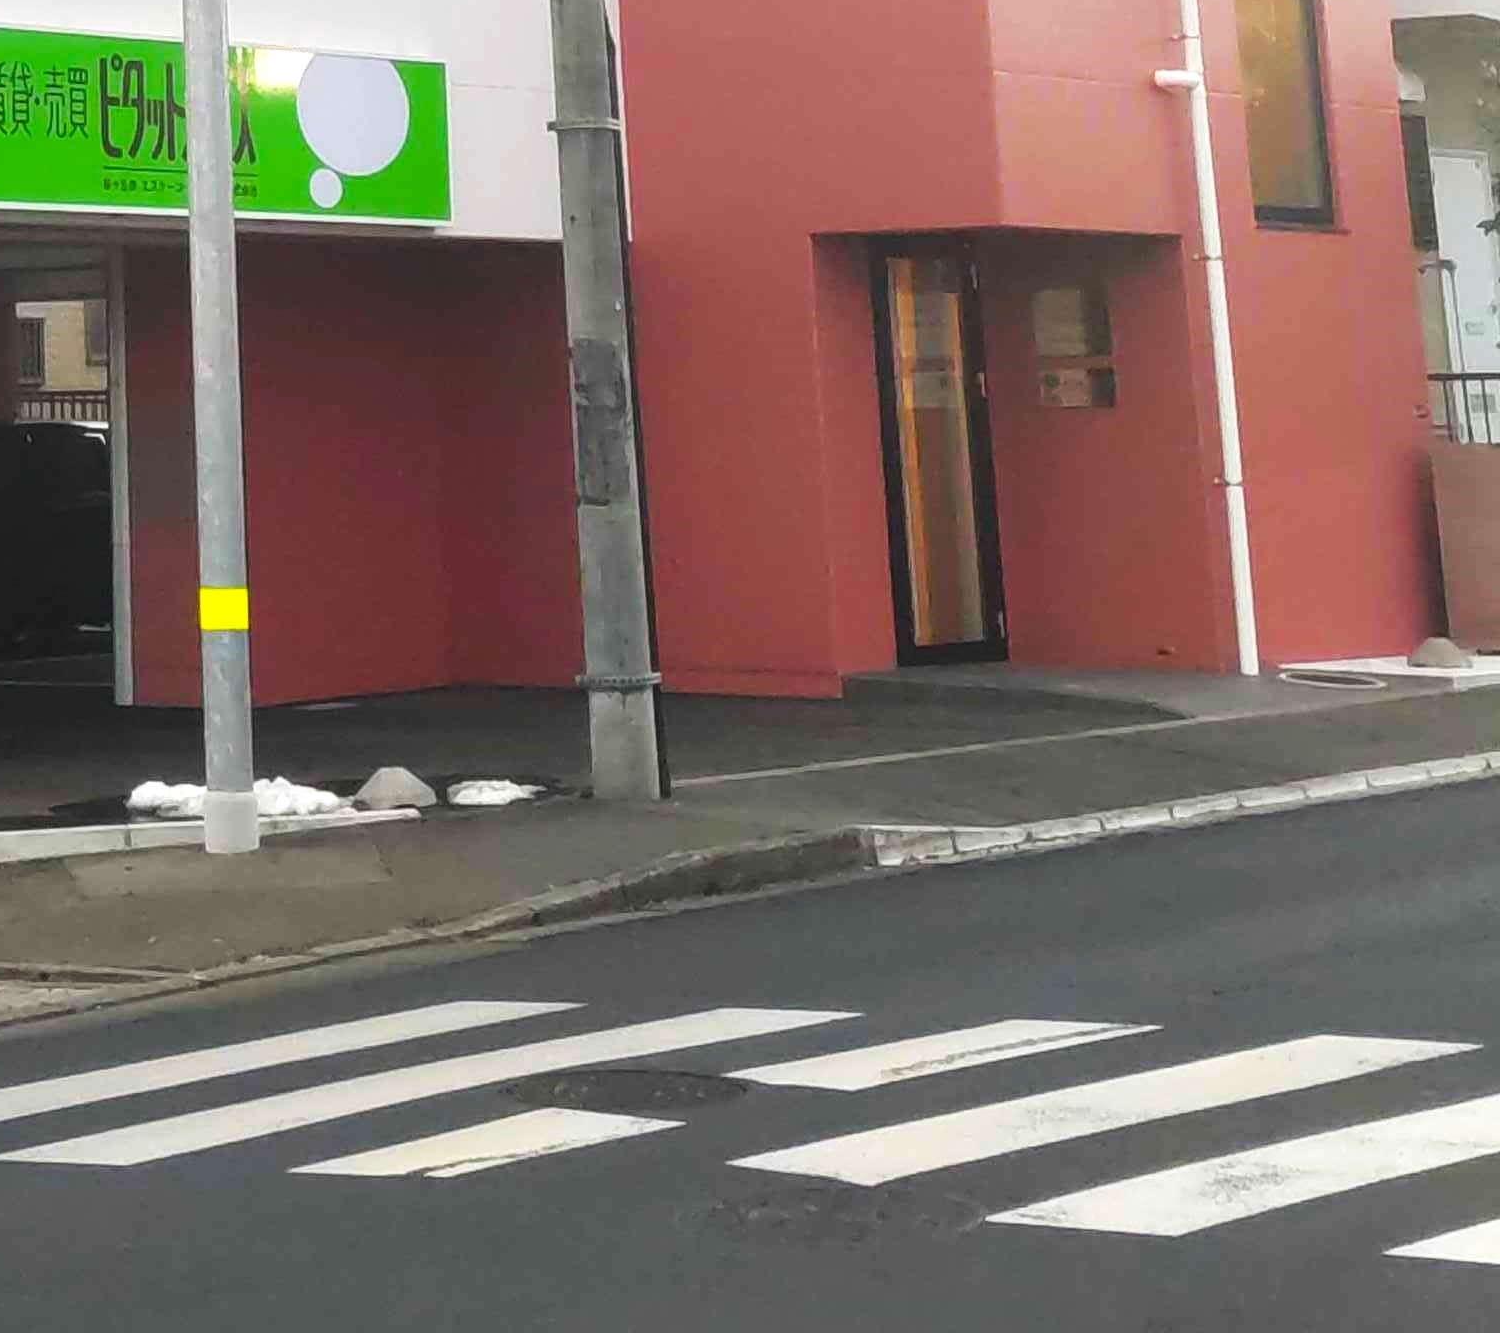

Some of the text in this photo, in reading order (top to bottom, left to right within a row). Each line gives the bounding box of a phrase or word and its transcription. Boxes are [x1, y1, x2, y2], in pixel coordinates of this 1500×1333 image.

[99, 52, 257, 164] ピタットス
